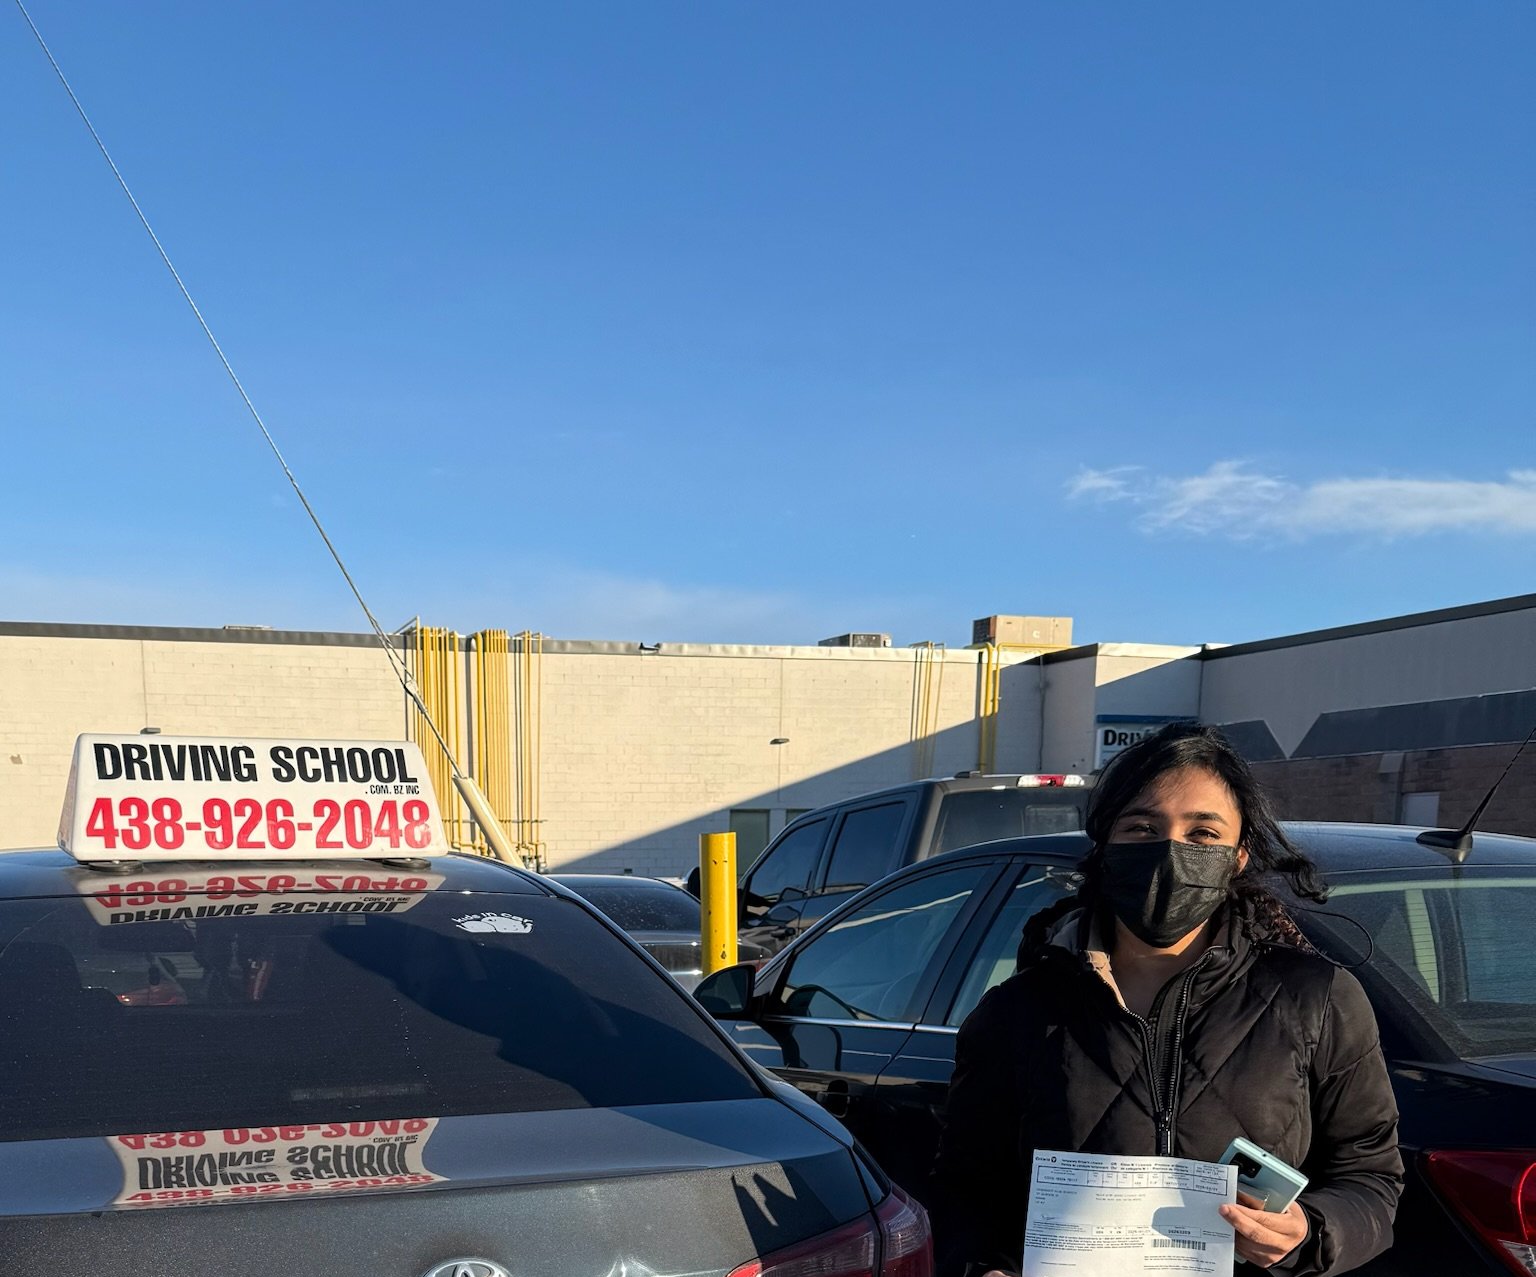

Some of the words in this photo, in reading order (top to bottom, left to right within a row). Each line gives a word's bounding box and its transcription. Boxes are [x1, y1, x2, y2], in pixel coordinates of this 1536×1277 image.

[93, 743, 258, 783] DRIVING
[270, 746, 419, 784] SCHOOL
[86, 796, 432, 850] 438-926-2048
